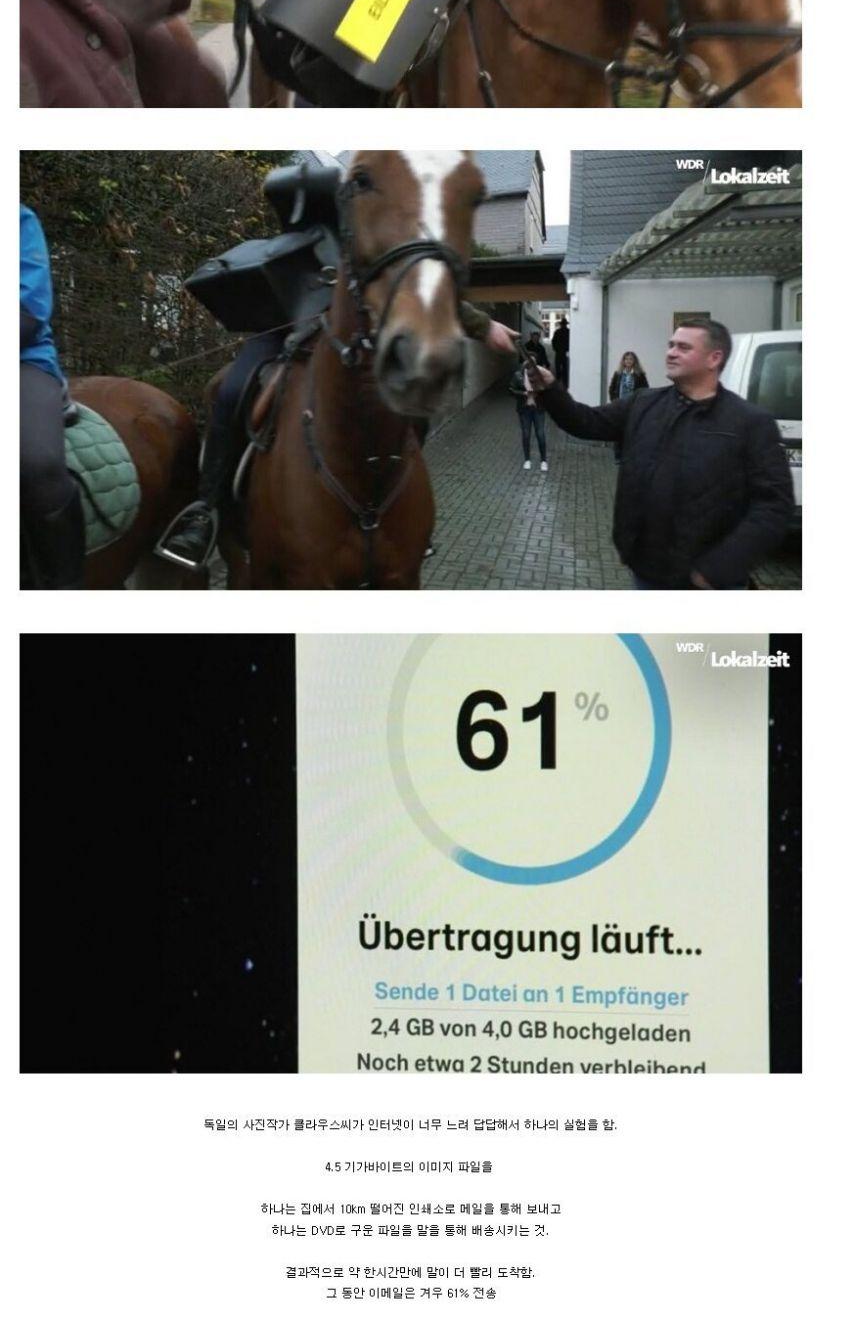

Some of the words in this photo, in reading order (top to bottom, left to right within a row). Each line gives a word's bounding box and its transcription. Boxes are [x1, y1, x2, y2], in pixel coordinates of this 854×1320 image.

[456, 689, 557, 772] 61
[574, 691, 610, 722] %
[358, 913, 581, 961] Übertragung
[591, 923, 703, 956] läuft...
[374, 982, 440, 1000] Sende
[446, 984, 455, 1000] 1
[463, 984, 518, 1002] Datei
[523, 988, 549, 1003] an
[556, 986, 564, 1002] 1
[572, 985, 690, 1010] Empfänger
[370, 1017, 401, 1038] 2,4
[406, 1018, 435, 1036] GB
[440, 1022, 477, 1037] von
[482, 1020, 513, 1040] 4,0
[518, 1020, 548, 1039] GB
[553, 1021, 691, 1045] hochgeladen
[357, 1053, 409, 1072] Noch
[414, 1055, 465, 1073] etwa
[470, 1055, 482, 1073] 2
[487, 1055, 574, 1074] Stunden
